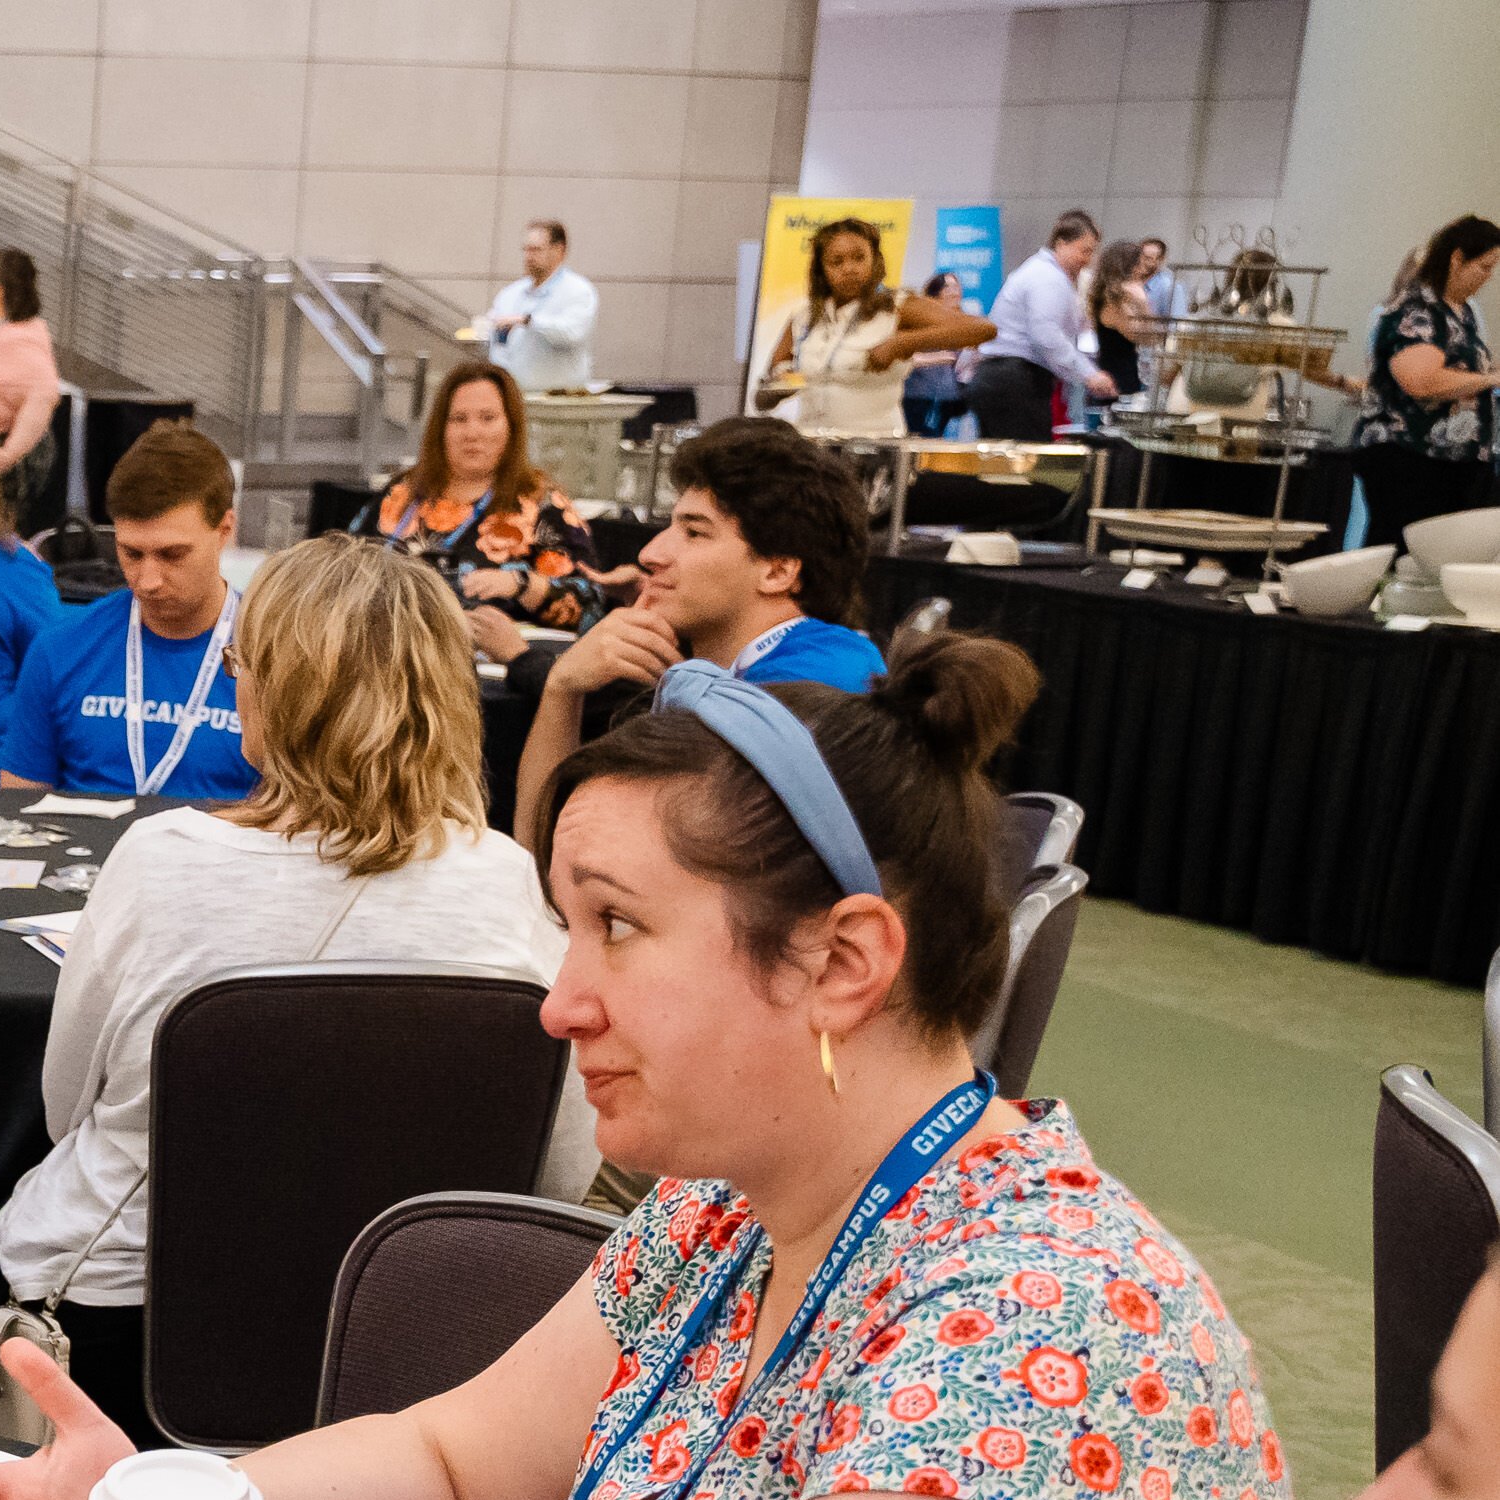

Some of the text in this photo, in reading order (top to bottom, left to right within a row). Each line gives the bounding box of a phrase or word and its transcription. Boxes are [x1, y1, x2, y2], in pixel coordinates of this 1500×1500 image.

[81, 695, 242, 734] GIVCAPUS
[911, 1088, 986, 1155] GIVECA
[790, 1183, 891, 1336] GIVECAMPUS
[594, 1333, 687, 1472] GIVECAMPUS
